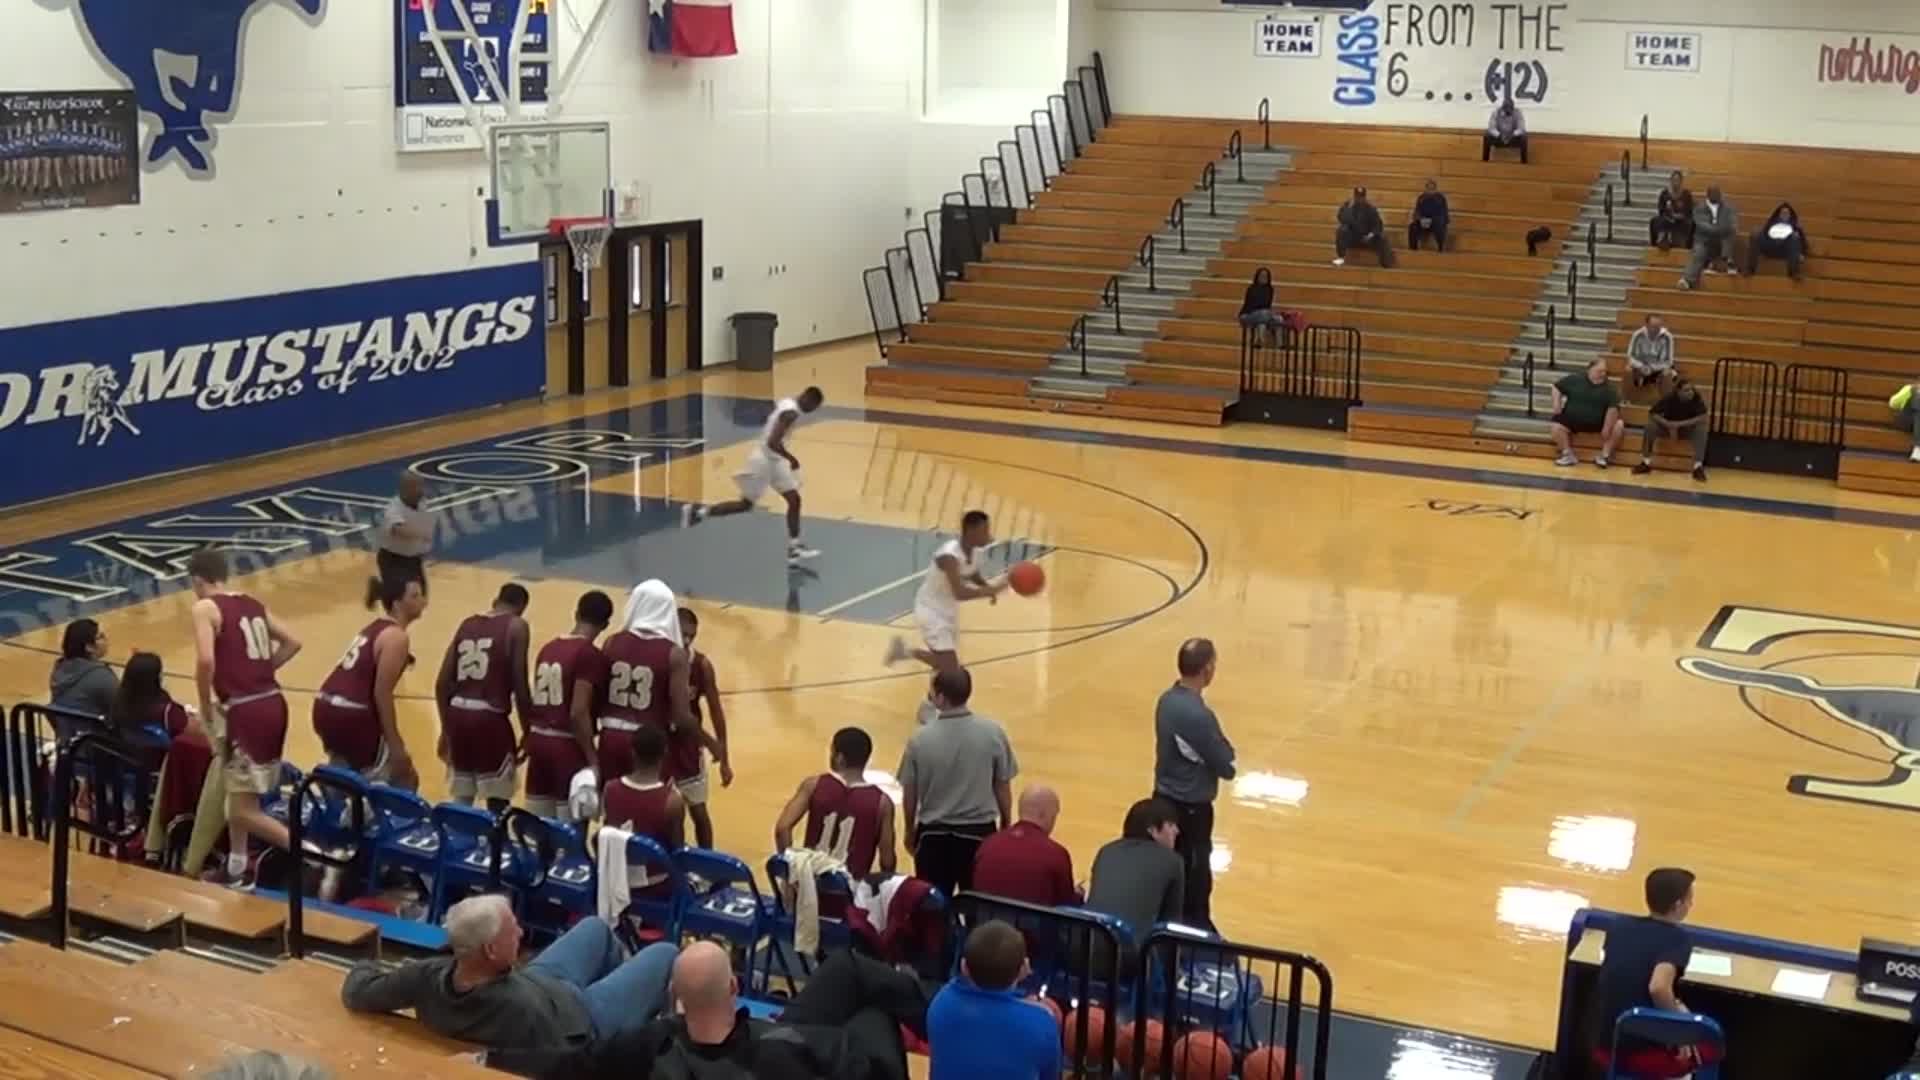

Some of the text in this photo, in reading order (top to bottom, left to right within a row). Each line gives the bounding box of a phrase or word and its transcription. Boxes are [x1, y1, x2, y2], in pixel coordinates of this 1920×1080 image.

[1263, 24, 1314, 37] HOME
[1264, 40, 1314, 53] TEAM
[1385, 4, 1568, 51] FROM THE
[1635, 36, 1692, 50] HOME
[1333, 15, 1380, 106] CLASS
[1636, 53, 1691, 66] TEAM
[1818, 37, 1920, 95] nothing
[117, 295, 536, 406] MUSTANGS
[196, 345, 457, 412] Class of 2002
[239, 615, 272, 660] 10
[456, 637, 493, 681] 25
[607, 660, 654, 711] 23
[815, 812, 855, 863] 11
